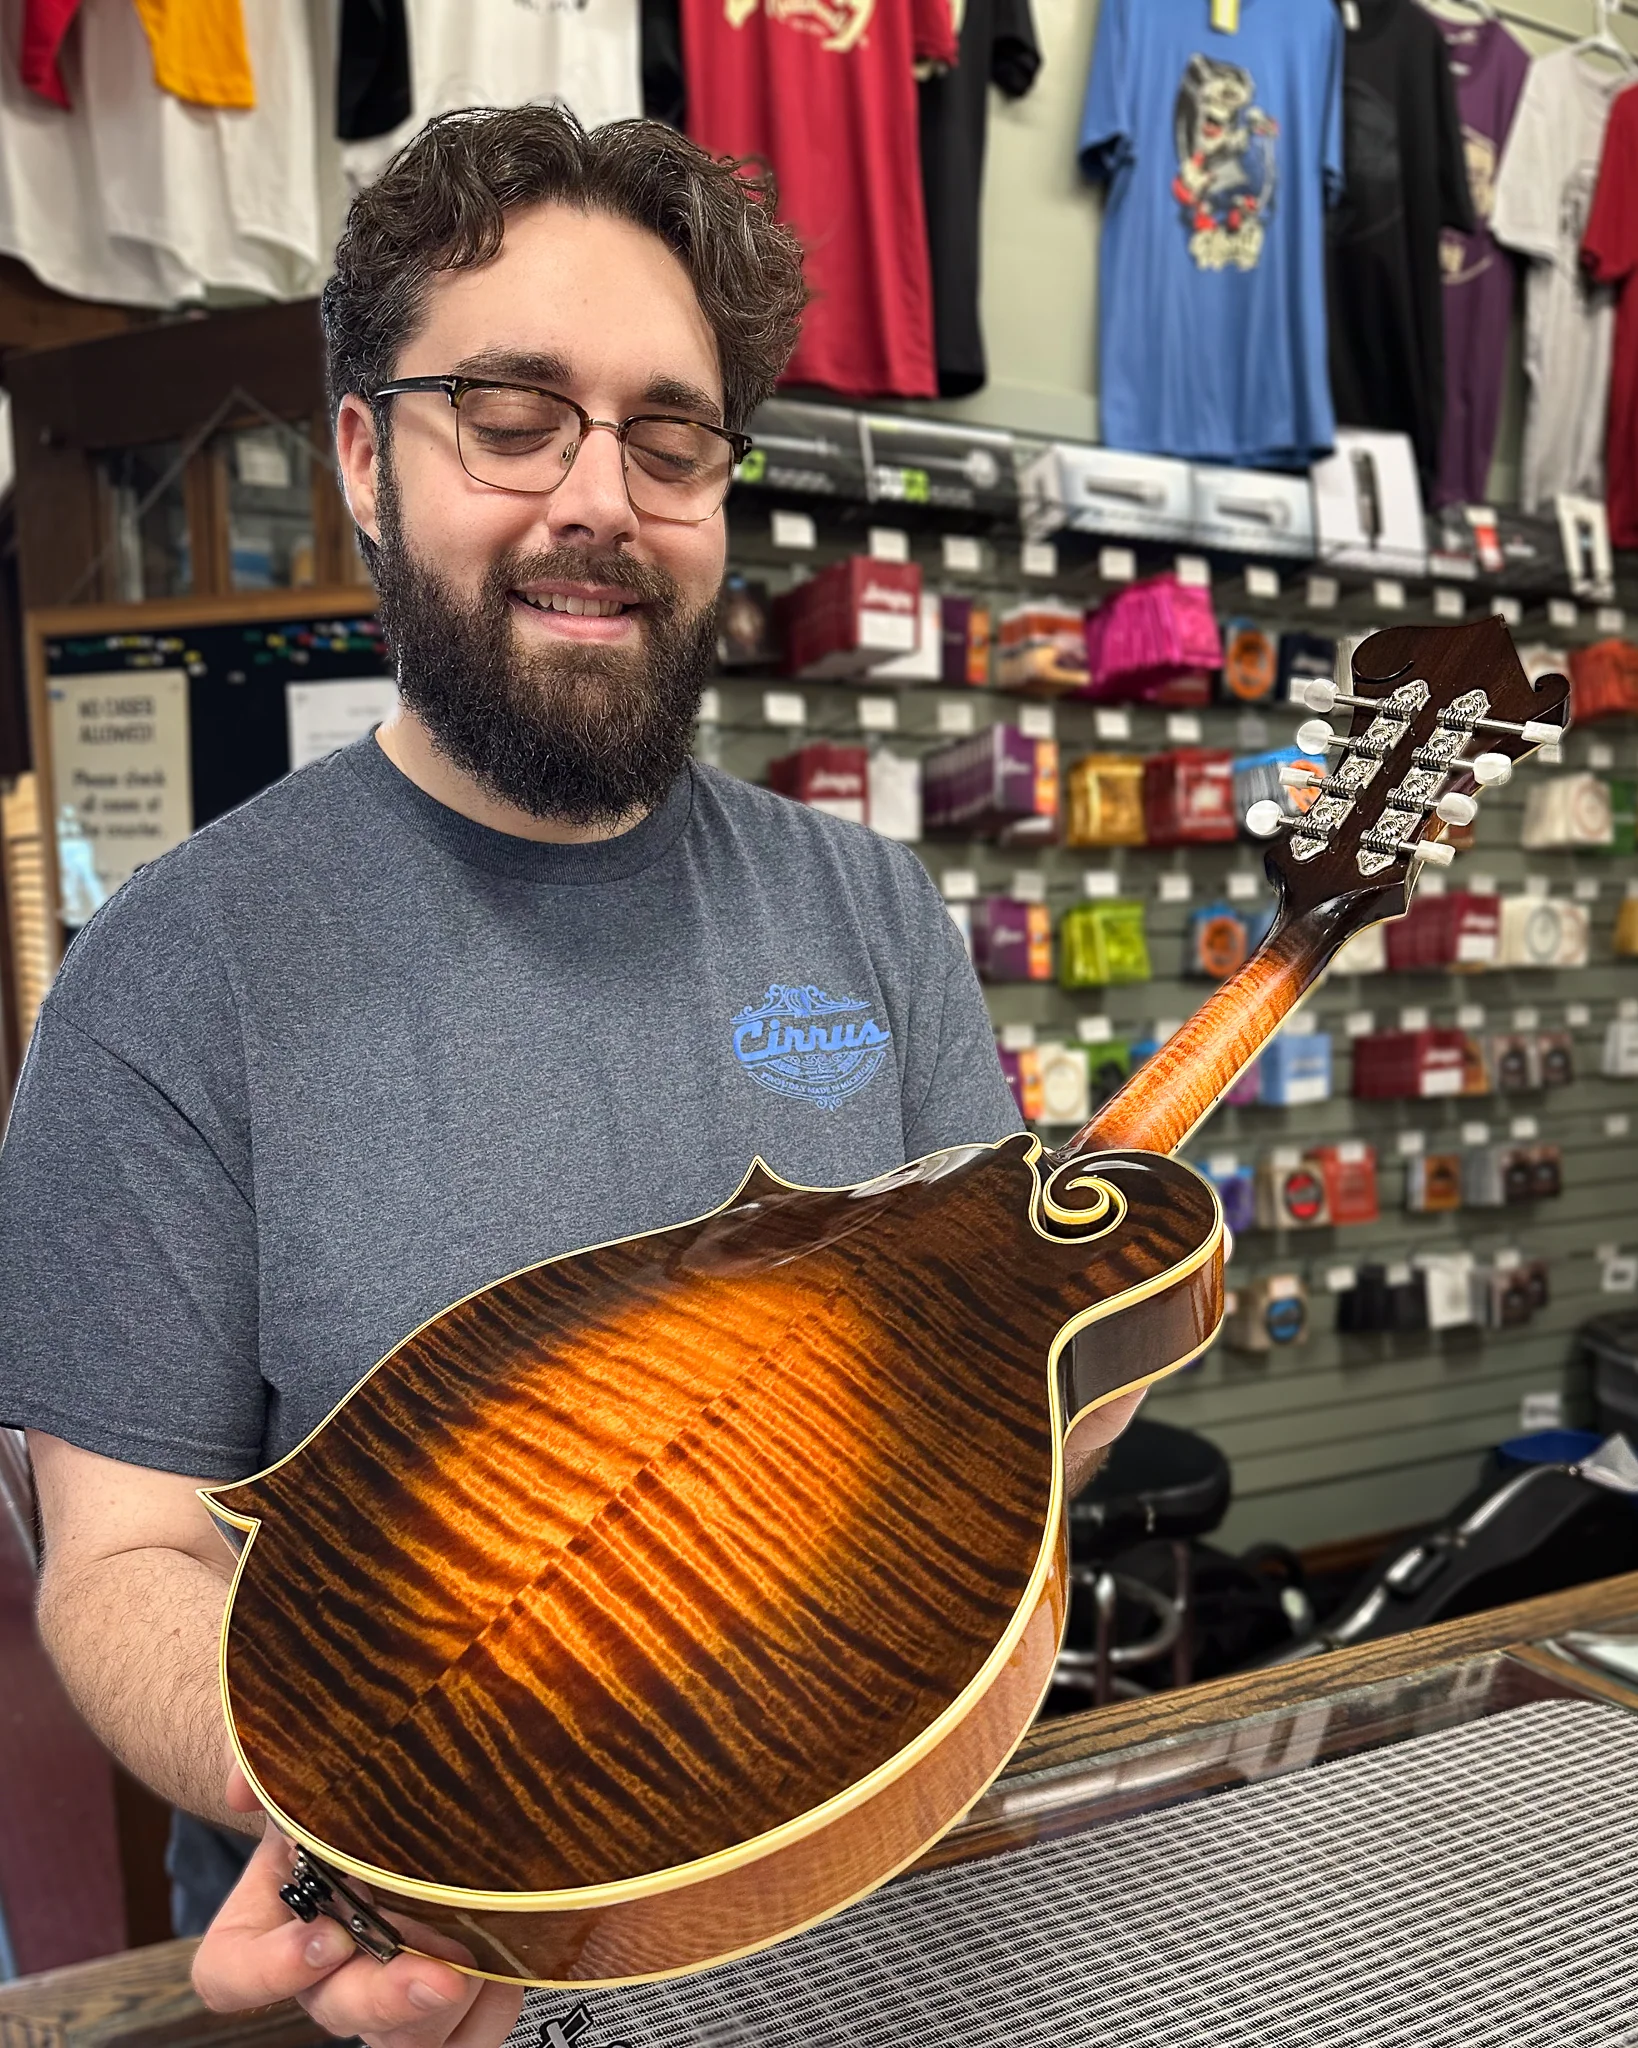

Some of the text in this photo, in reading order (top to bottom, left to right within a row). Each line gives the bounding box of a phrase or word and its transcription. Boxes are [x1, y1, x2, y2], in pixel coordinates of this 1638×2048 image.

[733, 1019, 889, 1062] Cirrus
[761, 1072, 806, 1092] PROUDLY
[807, 1086, 831, 1094] MADE
[841, 1057, 875, 1090] MICHIGAN
